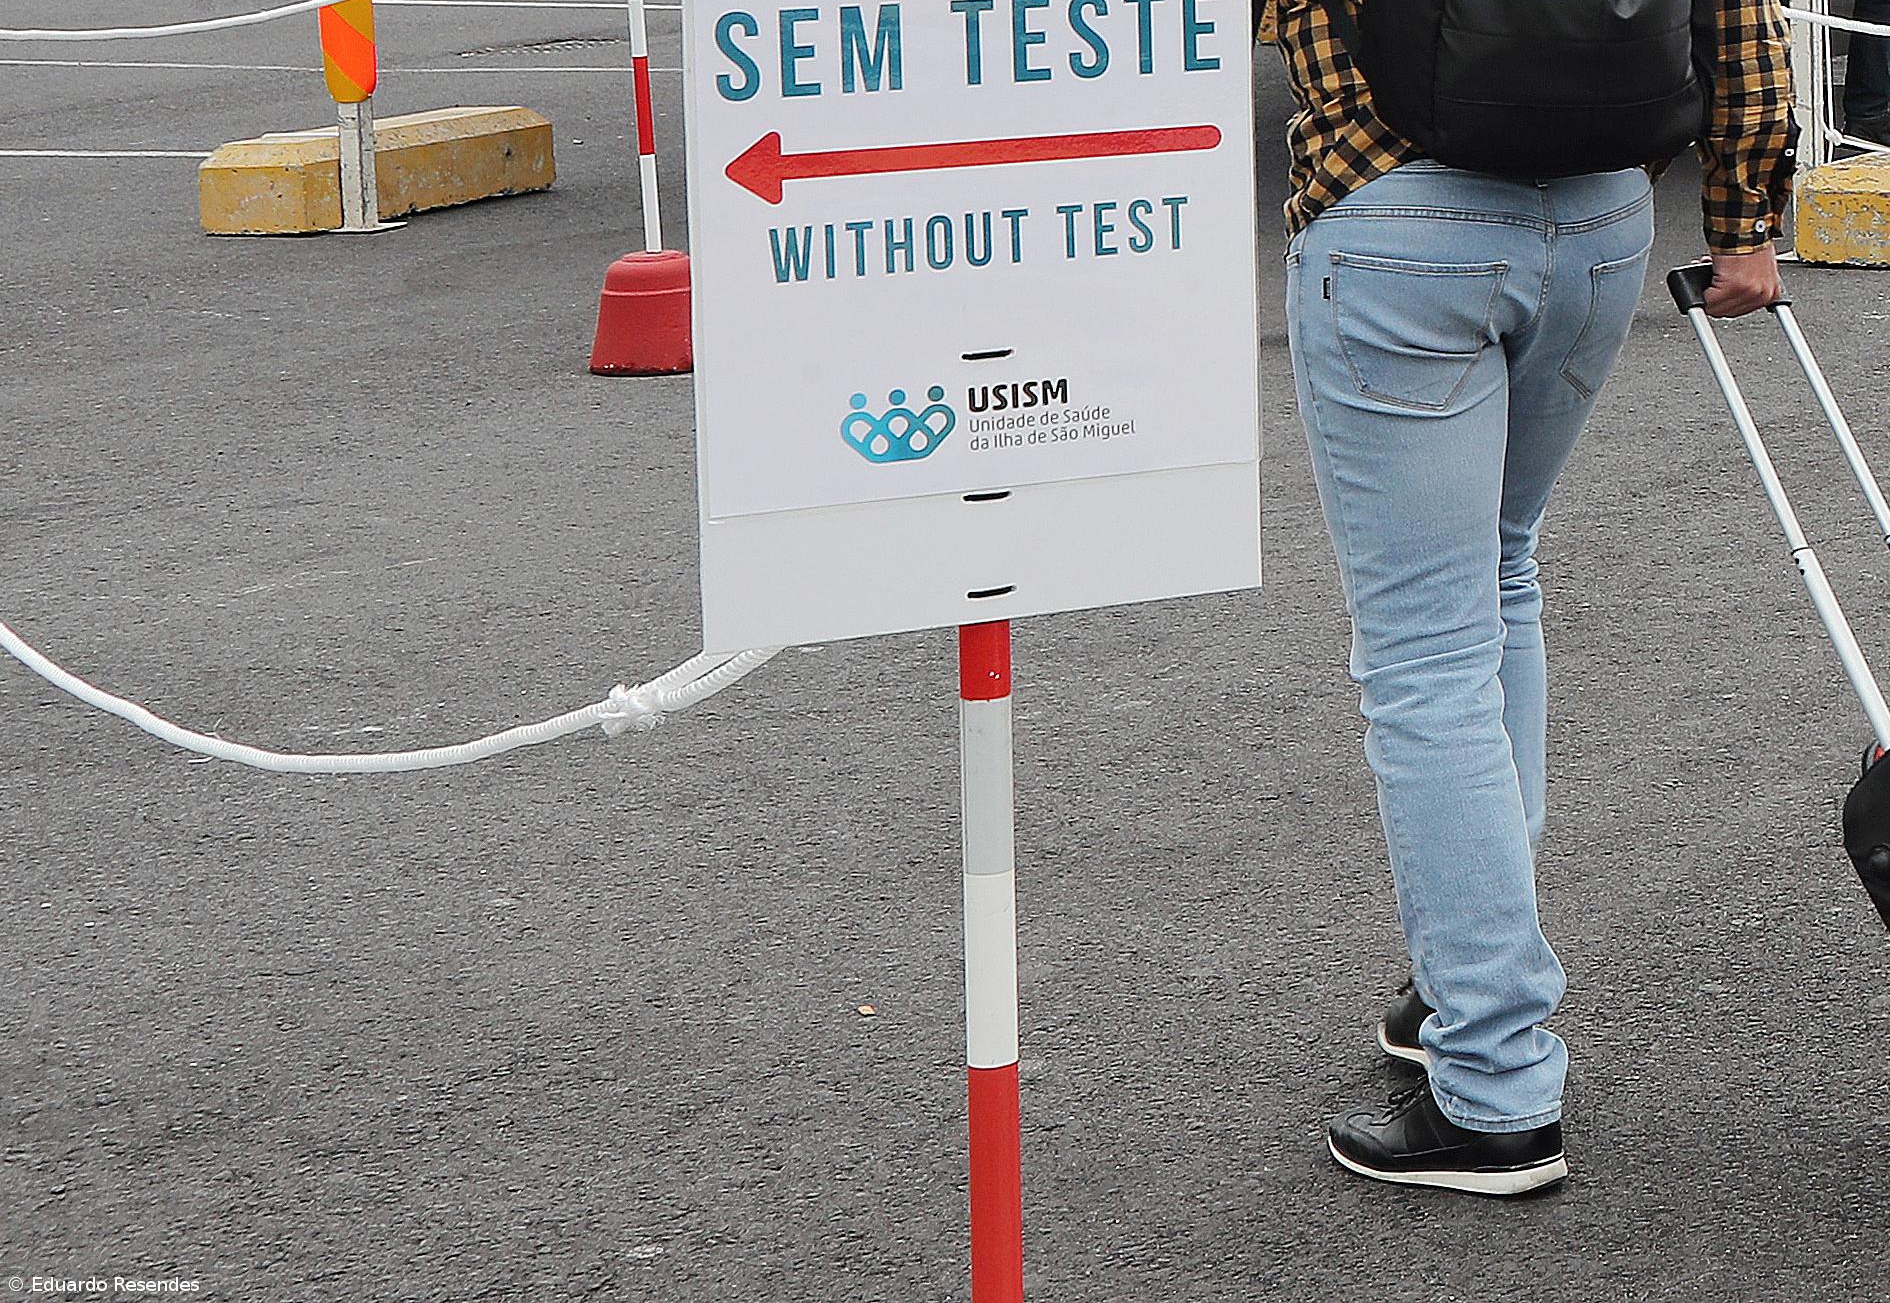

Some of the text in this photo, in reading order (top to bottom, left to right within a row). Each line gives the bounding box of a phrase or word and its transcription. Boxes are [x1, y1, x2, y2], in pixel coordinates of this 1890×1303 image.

[715, 2, 903, 102] SEM
[768, 195, 1189, 284] WITHOUT TEST
[968, 378, 1068, 413] USISM
[969, 404, 1111, 433] Unidade de Saúde
[970, 419, 1136, 451] da Ilha de São Miguel
